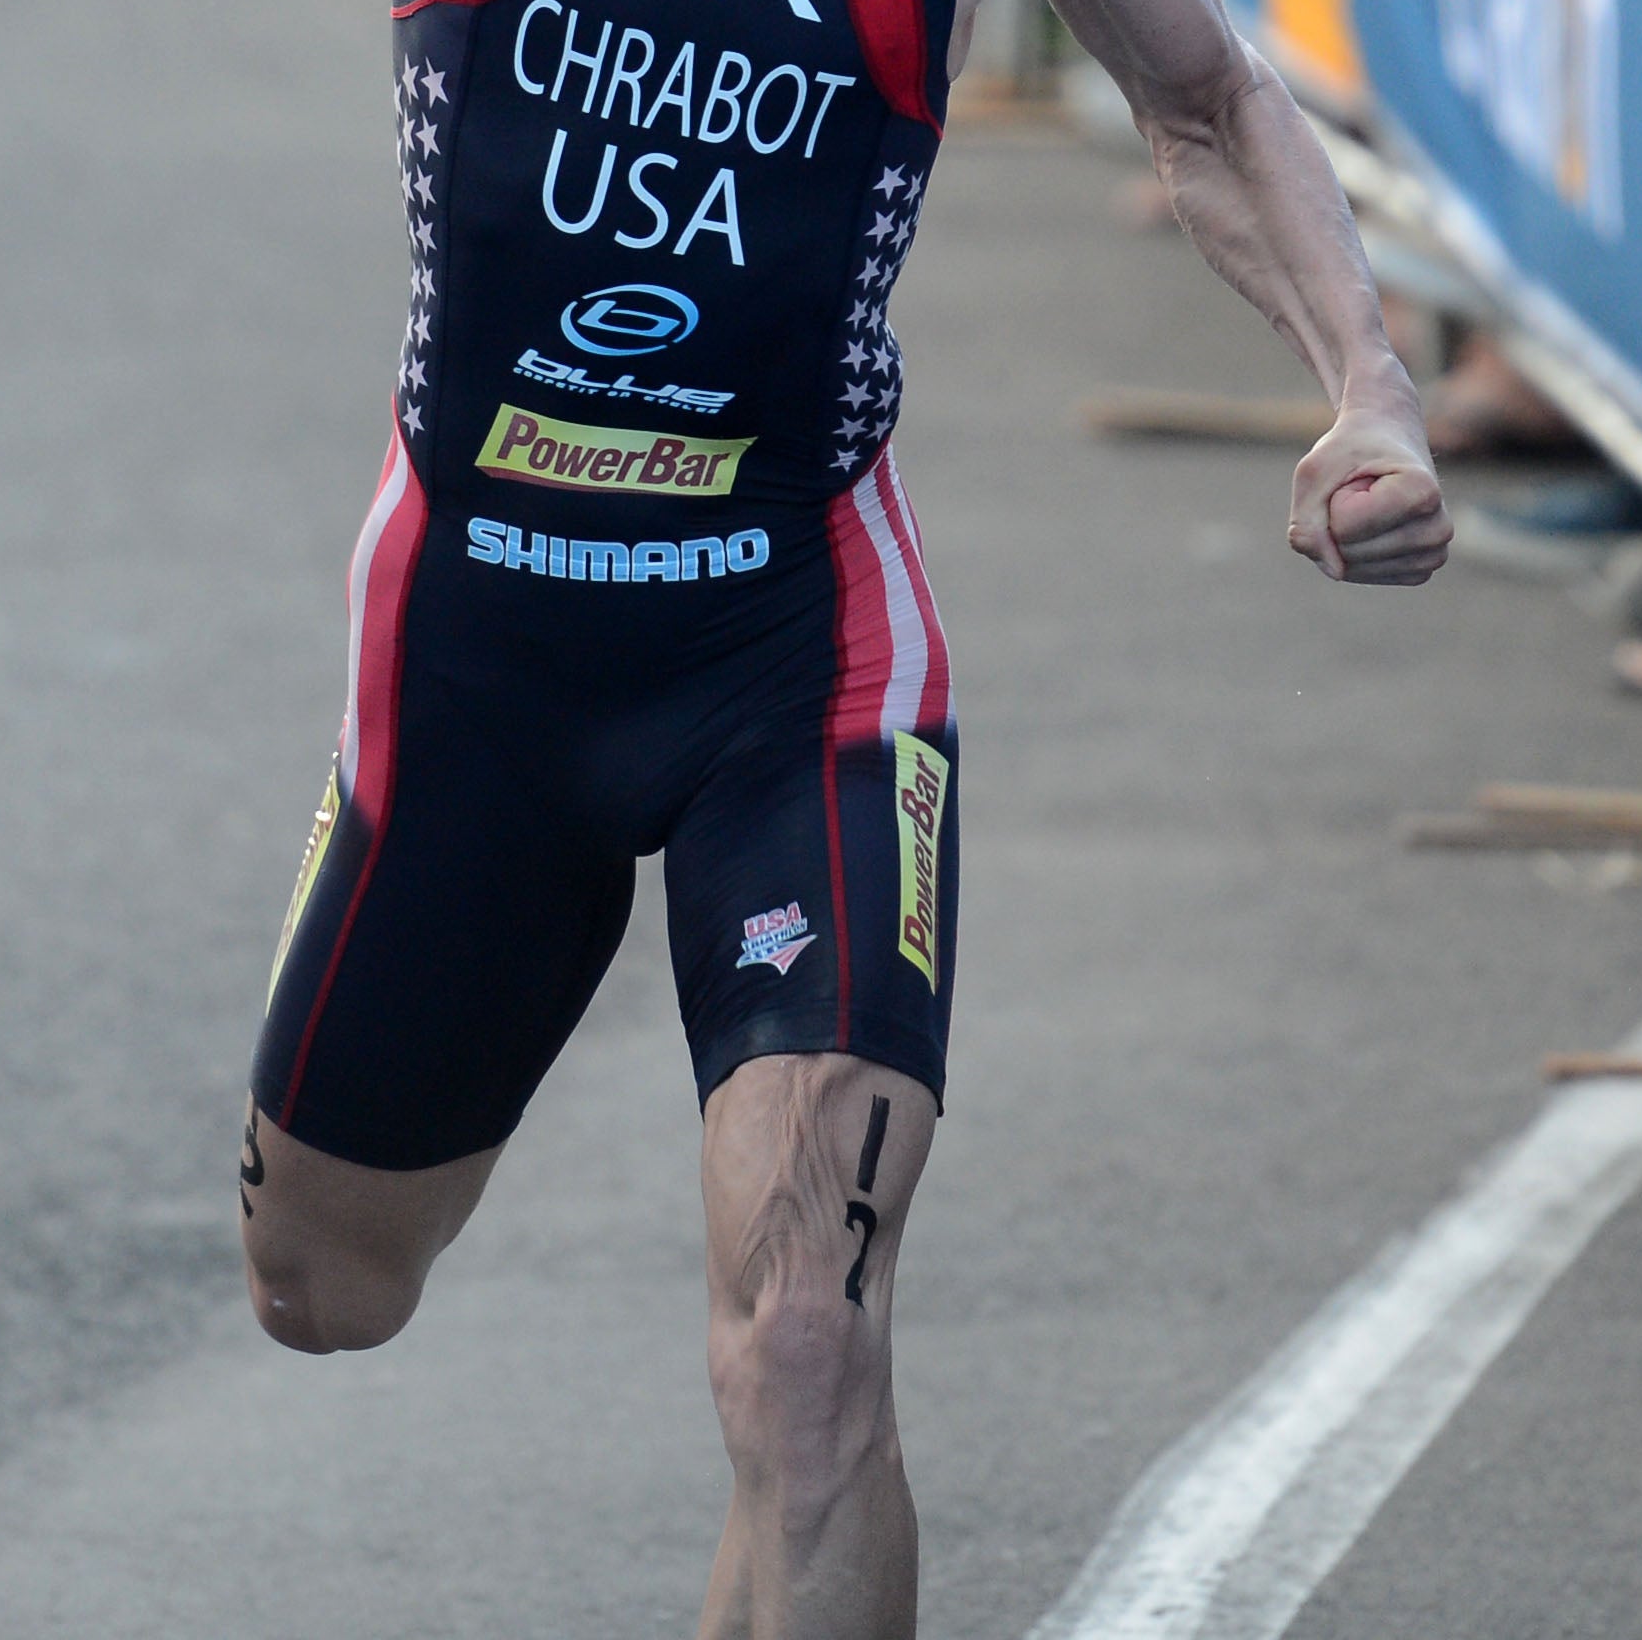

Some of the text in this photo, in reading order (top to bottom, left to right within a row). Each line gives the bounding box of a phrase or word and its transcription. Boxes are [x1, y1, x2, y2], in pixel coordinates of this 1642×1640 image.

[541, 127, 745, 267] USA
[496, 411, 732, 488] PowerBar
[467, 516, 771, 583] SHIMANO
[900, 751, 941, 969] PowerBar
[743, 901, 802, 940] USA
